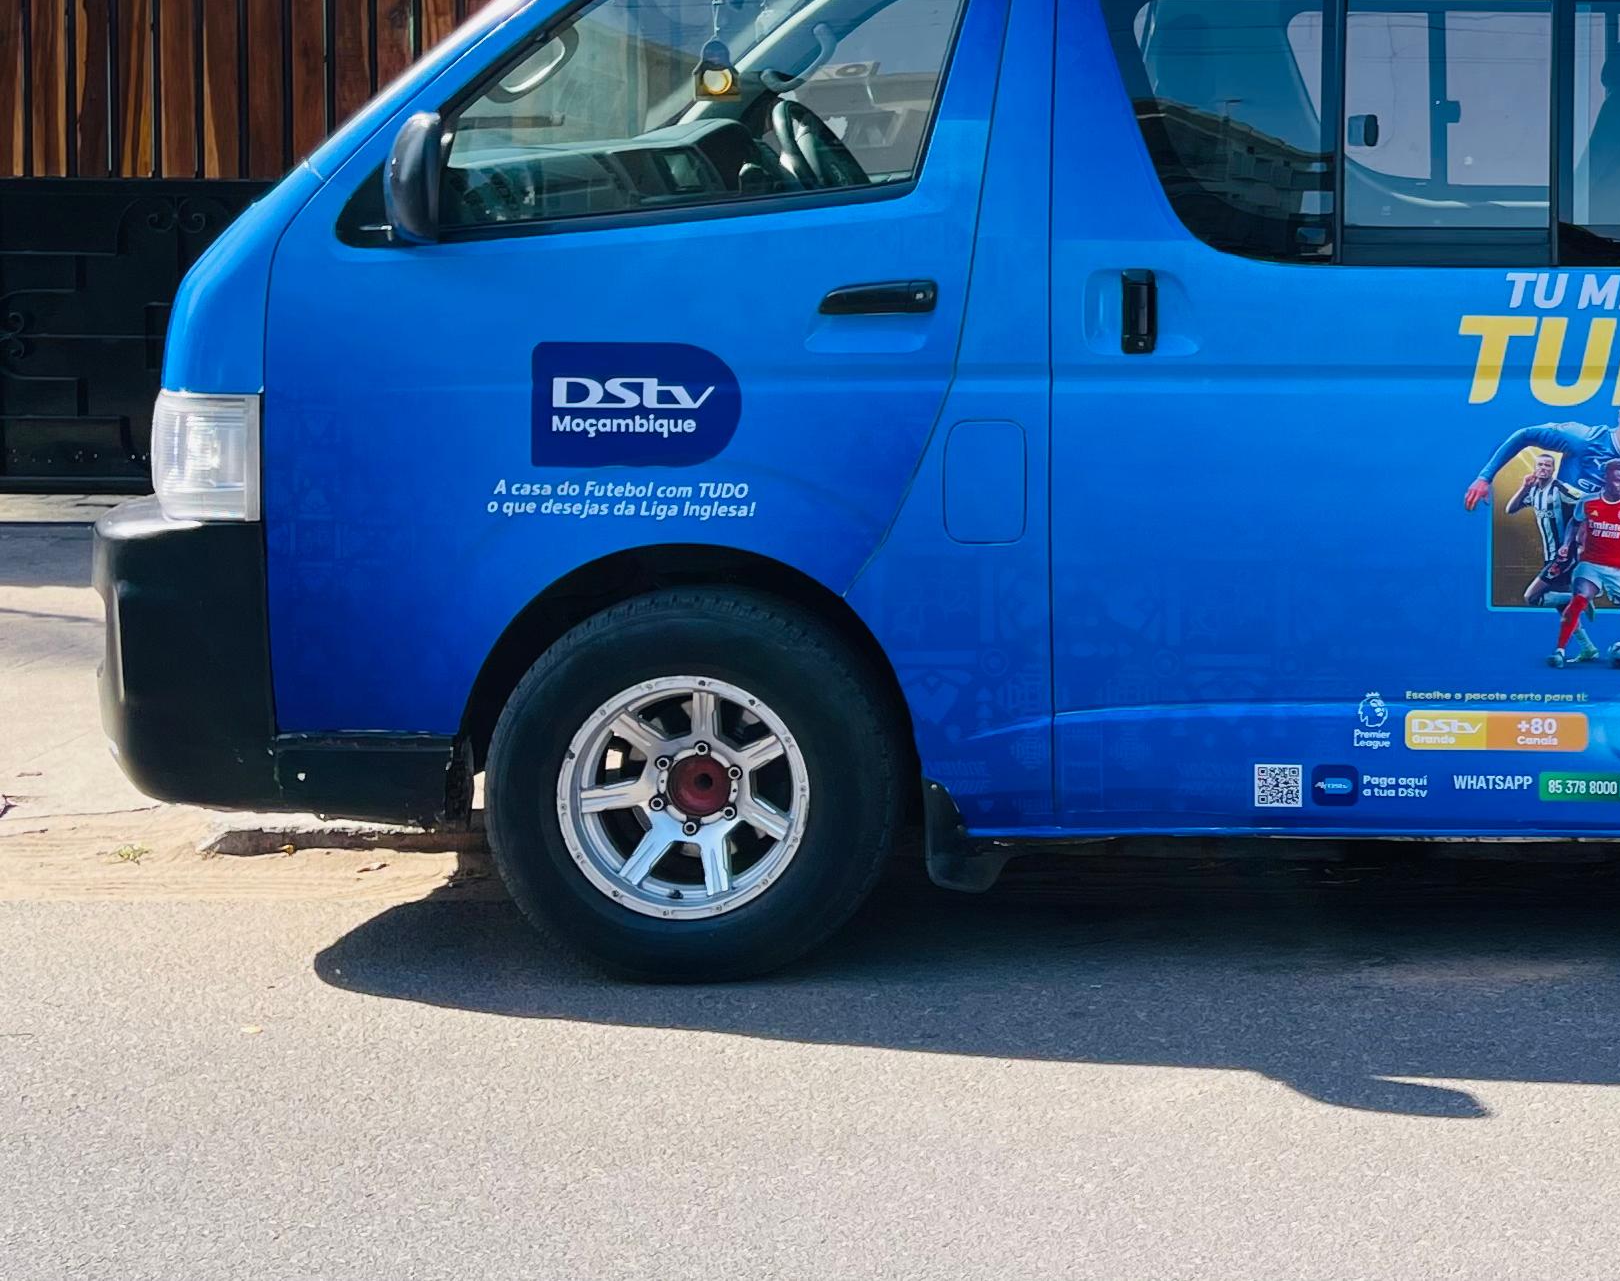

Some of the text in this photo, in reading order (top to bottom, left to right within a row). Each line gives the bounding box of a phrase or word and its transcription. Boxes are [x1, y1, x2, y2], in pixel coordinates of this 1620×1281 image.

[1505, 272, 1568, 310] TU
[552, 377, 715, 409] DStv
[551, 415, 697, 438] Moçambique
[494, 479, 749, 498] A casa do Futebol com TUDO
[487, 499, 756, 520] o que desejas da Liga Inglesa!
[1405, 691, 1451, 700] Escolhe
[1465, 692, 1507, 702] pacote
[1510, 692, 1541, 701] certo
[1544, 694, 1573, 703] para
[1411, 718, 1557, 734] DStv +80
[1353, 729, 1391, 739] Premier
[1412, 735, 1558, 745] Grande Canais
[1353, 737, 1391, 749] League
[1363, 775, 1396, 788] Paga
[1453, 775, 1533, 790] WHATSAPP
[1548, 780, 1618, 795] 85 378 8000
[1363, 788, 1428, 798] a tua DStv
